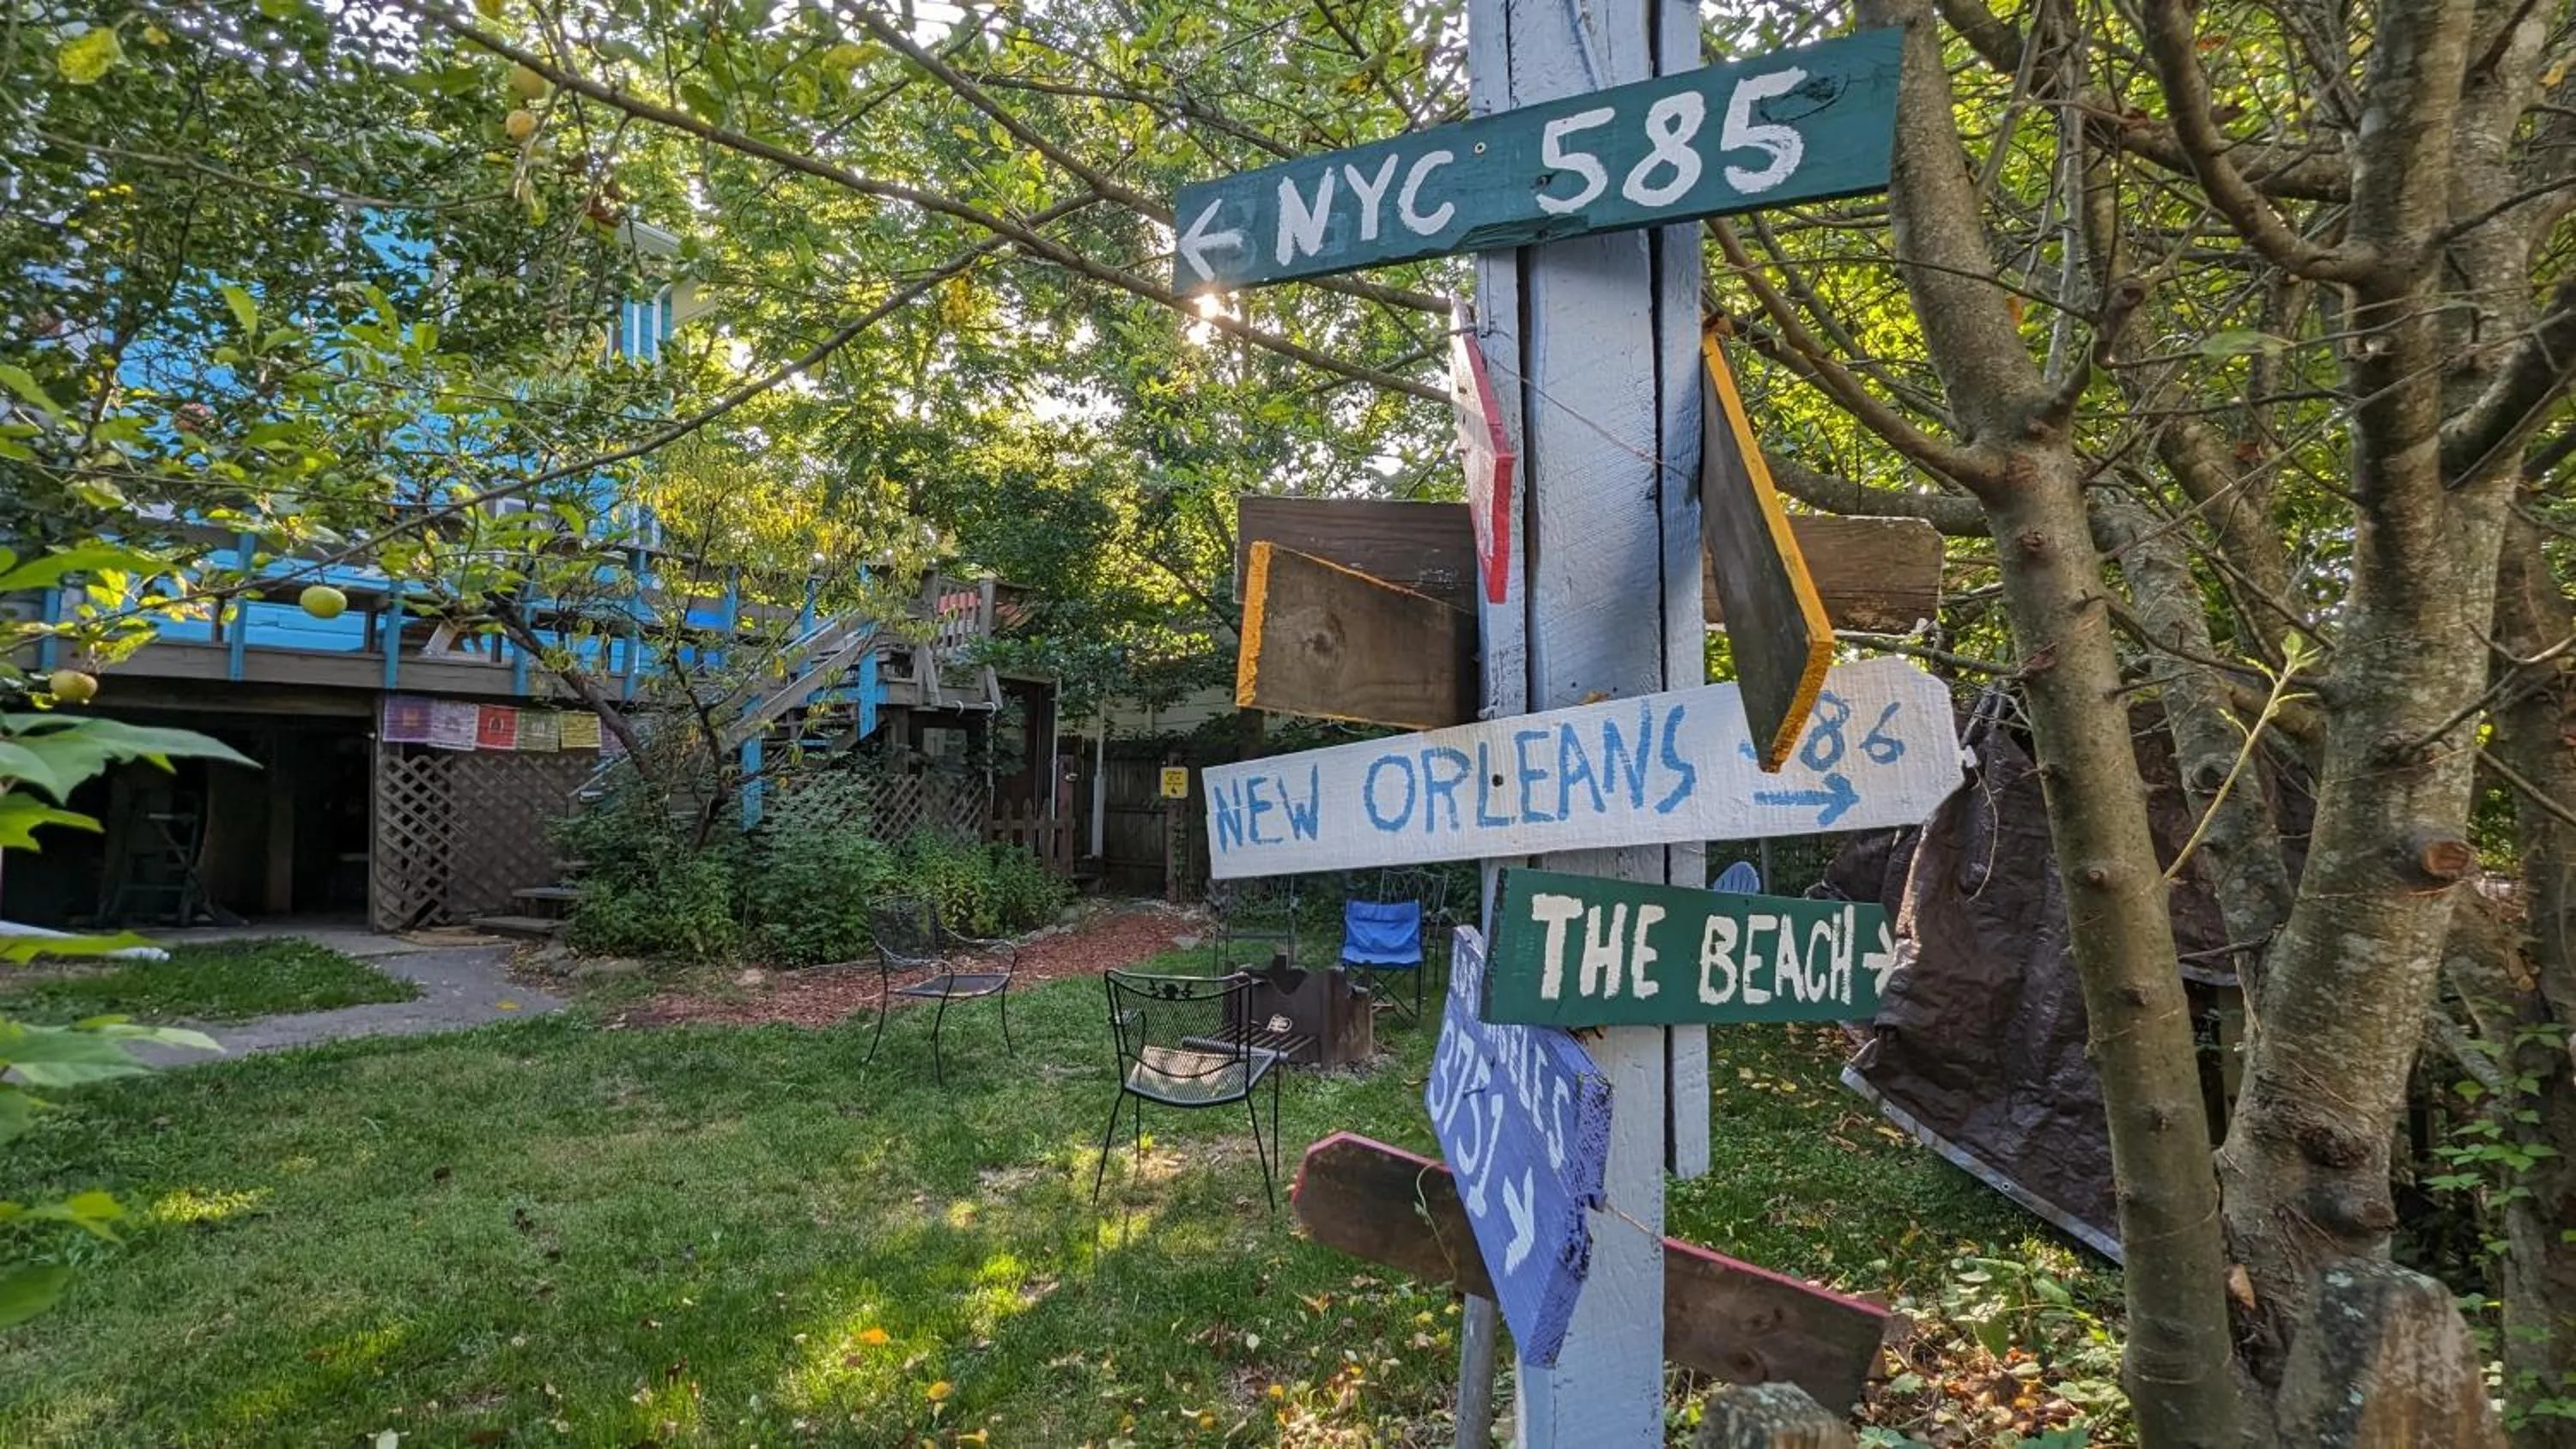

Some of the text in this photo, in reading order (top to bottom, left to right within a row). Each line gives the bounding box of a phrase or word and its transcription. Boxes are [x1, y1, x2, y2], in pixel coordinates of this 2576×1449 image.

[1275, 67, 1807, 266] NYC 585
[1214, 689, 1905, 852] NEW ORLEANS 86
[1532, 894, 1855, 1005] THE BEACH
[1429, 1019, 1504, 1217] 3751
